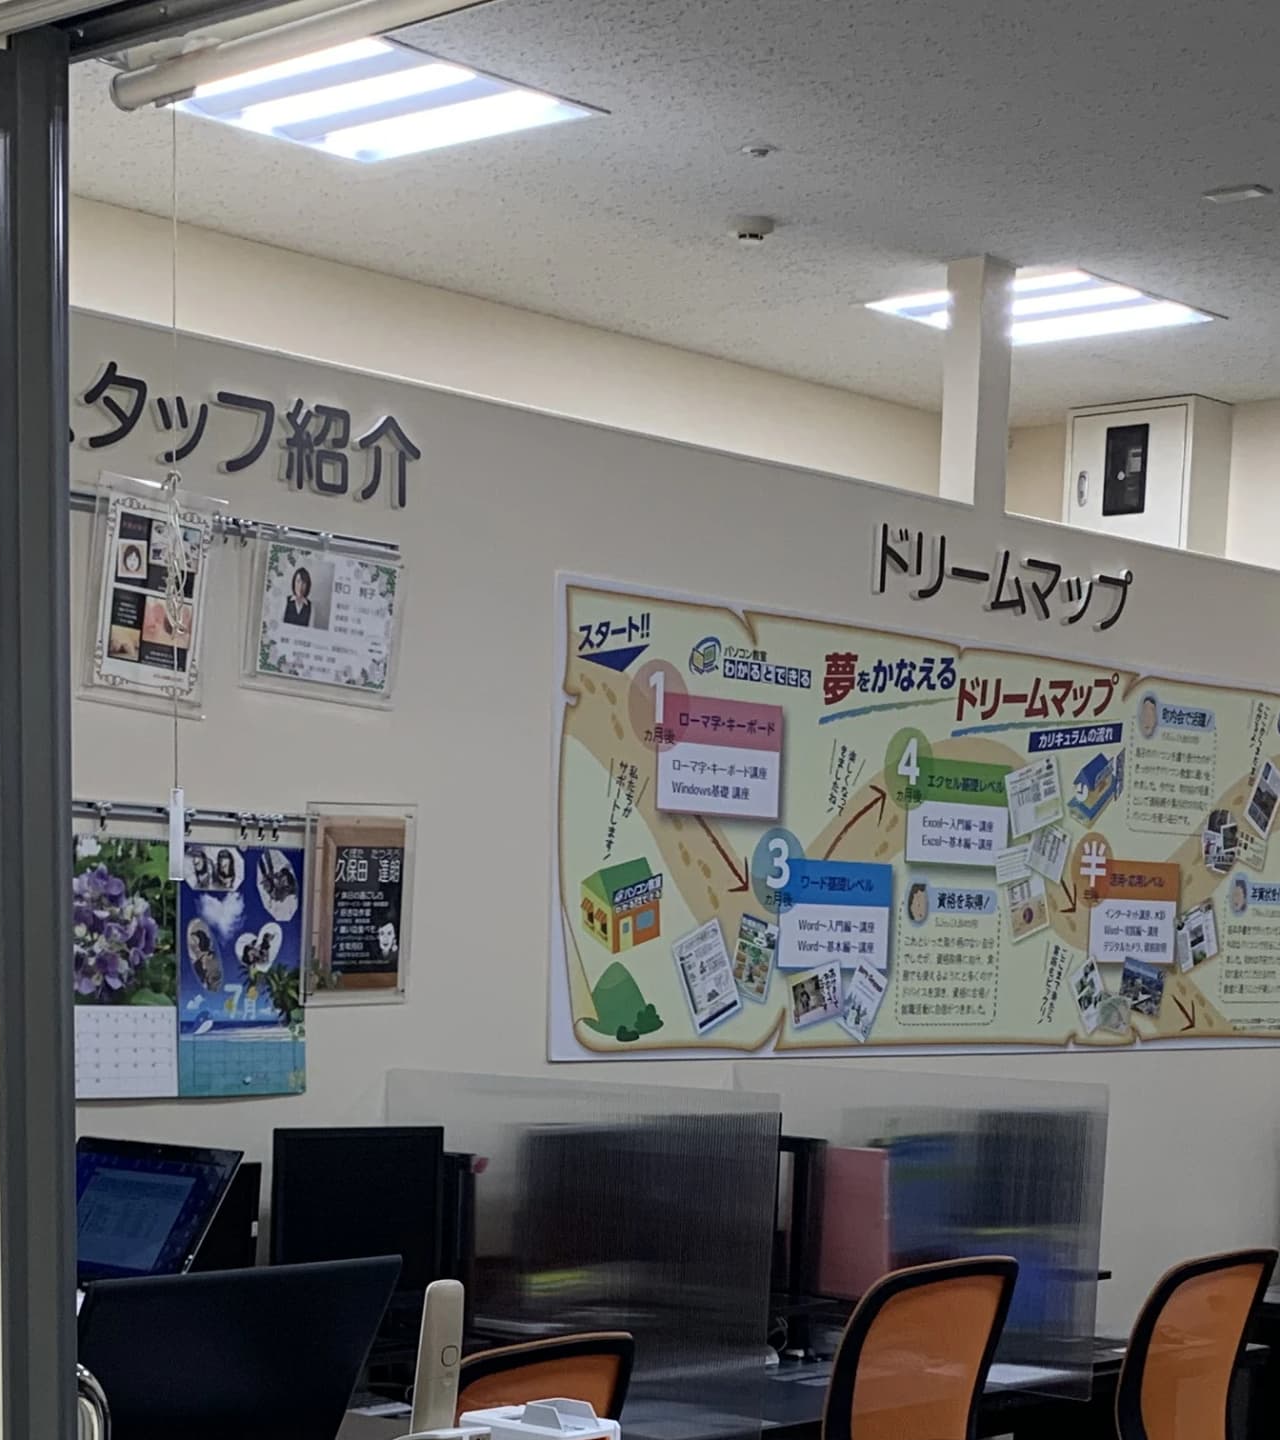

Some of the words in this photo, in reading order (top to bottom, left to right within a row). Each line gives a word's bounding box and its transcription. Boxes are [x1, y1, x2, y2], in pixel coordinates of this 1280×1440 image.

[70, 361, 421, 508] タッフ紹介
[878, 522, 1134, 631] ドリームマップ
[578, 613, 651, 651] スタート!!
[649, 671, 665, 724] 1
[723, 659, 812, 689] わかるとできる
[823, 651, 958, 706] 夢をかなえる
[956, 672, 1121, 722] ドリームマップ
[678, 712, 776, 737] ローマ字・キーボード
[1037, 728, 1114, 750] カリキュラムの流れ
[897, 738, 920, 786] 4
[335, 858, 369, 883] 久保田
[766, 838, 791, 889] 3
[1079, 840, 1107, 888] 半
